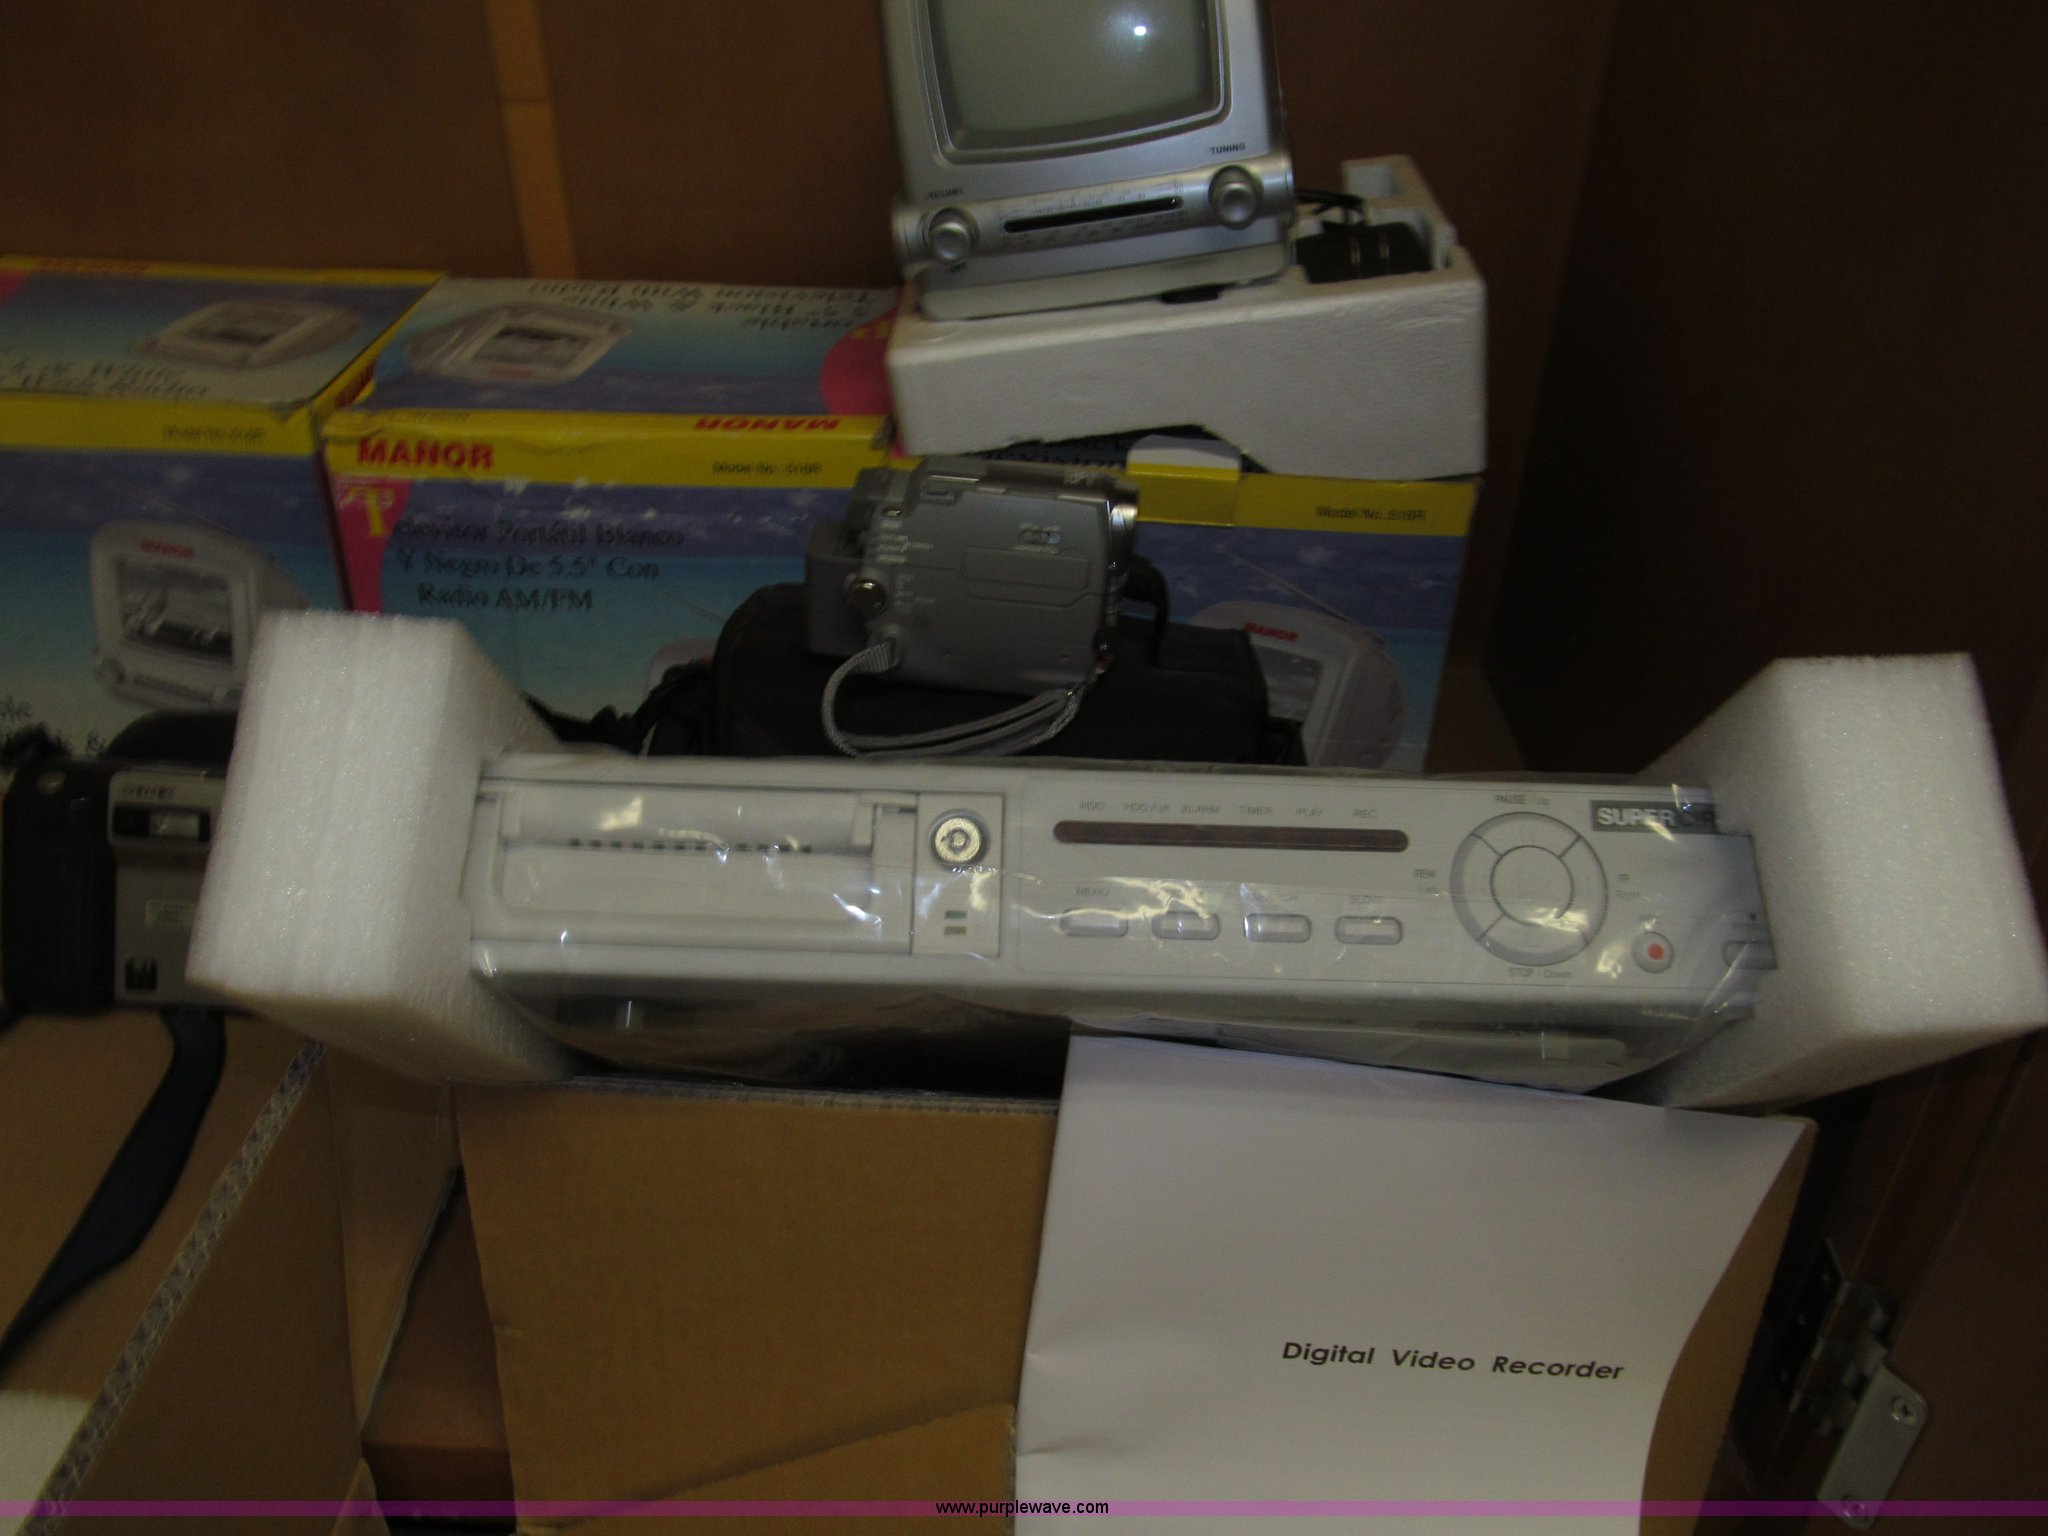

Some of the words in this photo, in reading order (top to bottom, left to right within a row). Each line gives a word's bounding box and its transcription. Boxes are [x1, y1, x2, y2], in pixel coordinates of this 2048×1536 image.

[1209, 142, 1246, 155] TUNING
[693, 417, 840, 432] MANOR
[357, 437, 494, 470] MANOR
[596, 522, 685, 547] Blanco
[395, 547, 416, 573] Y
[425, 549, 500, 577] Negro
[506, 553, 542, 577] De
[607, 555, 660, 579] Con
[417, 582, 490, 606] Radio
[496, 586, 595, 612] AM/FM
[1240, 806, 1273, 817] TIMER
[1296, 806, 1325, 817] PLAY
[1353, 808, 1378, 819] REC
[1597, 806, 1677, 827] SUPER
[1508, 966, 1535, 979] STOP
[1282, 1341, 1375, 1366] Digital
[1391, 1348, 1475, 1371] Video
[1492, 1355, 1625, 1380] Recorder
